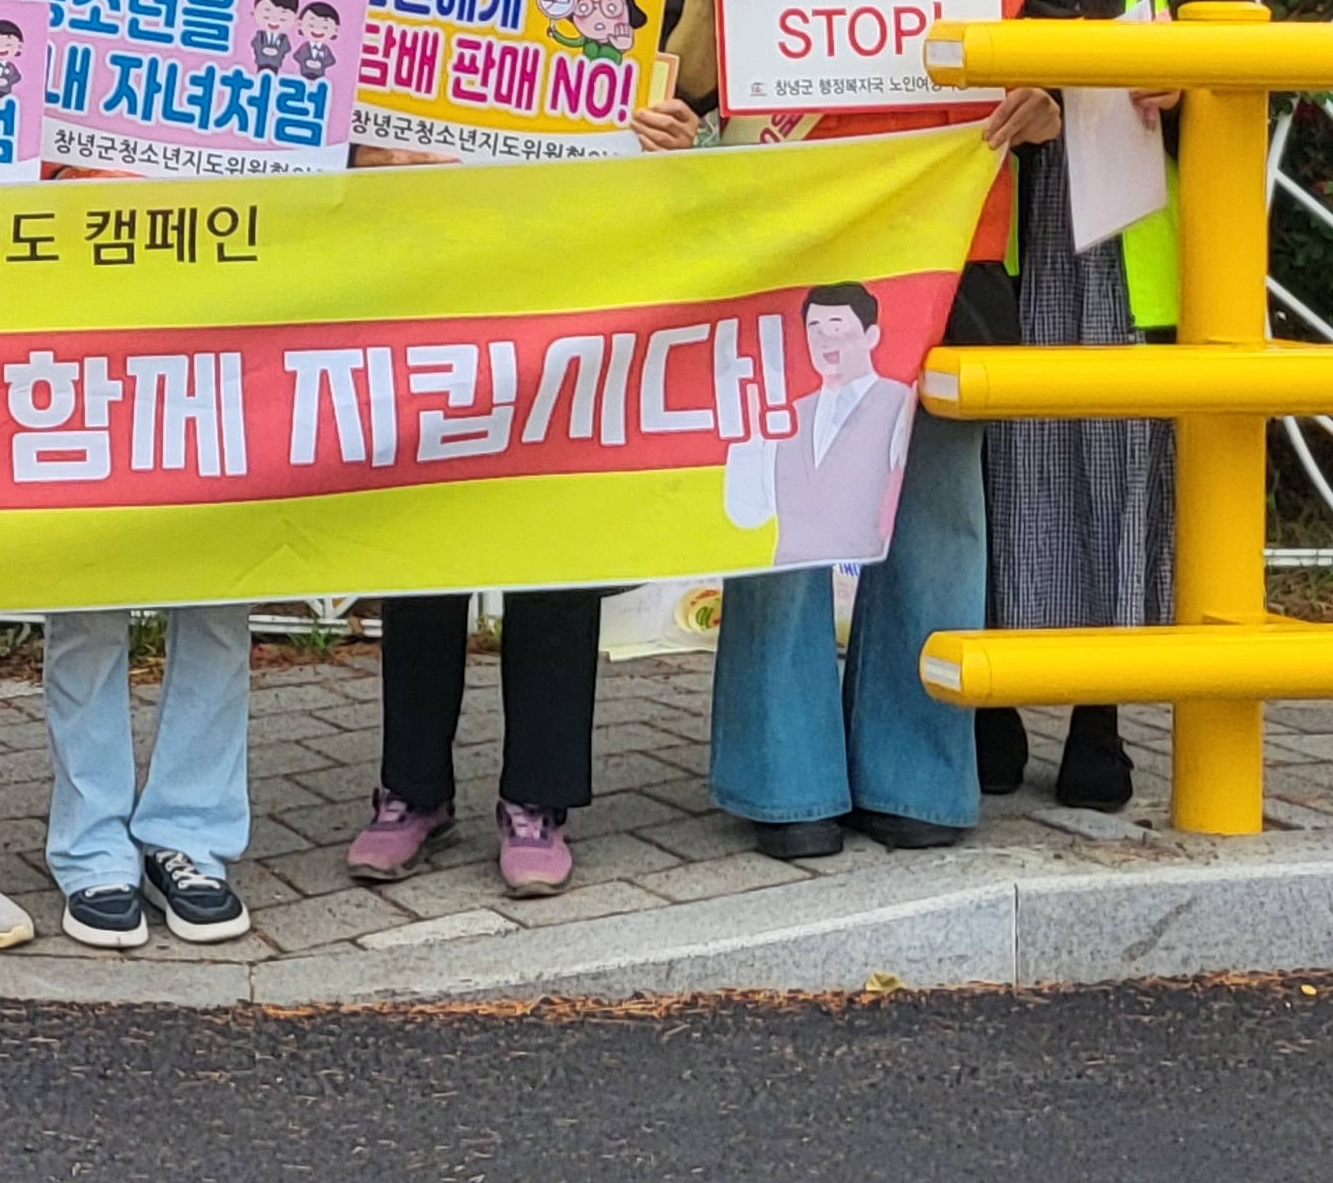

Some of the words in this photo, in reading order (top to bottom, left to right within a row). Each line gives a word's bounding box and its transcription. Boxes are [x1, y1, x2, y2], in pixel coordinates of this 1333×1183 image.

[44, 44, 92, 112] 내
[103, 53, 329, 148] 자녀처럼
[358, 23, 441, 96] 담배
[452, 38, 541, 111] 판매
[551, 56, 634, 123] NO!
[775, 78, 813, 96] 창녕군
[819, 76, 884, 95] 행정복지국
[86, 204, 260, 267] 캠페인
[3, 350, 247, 484] 함께
[284, 314, 791, 468] 지킵시다!
